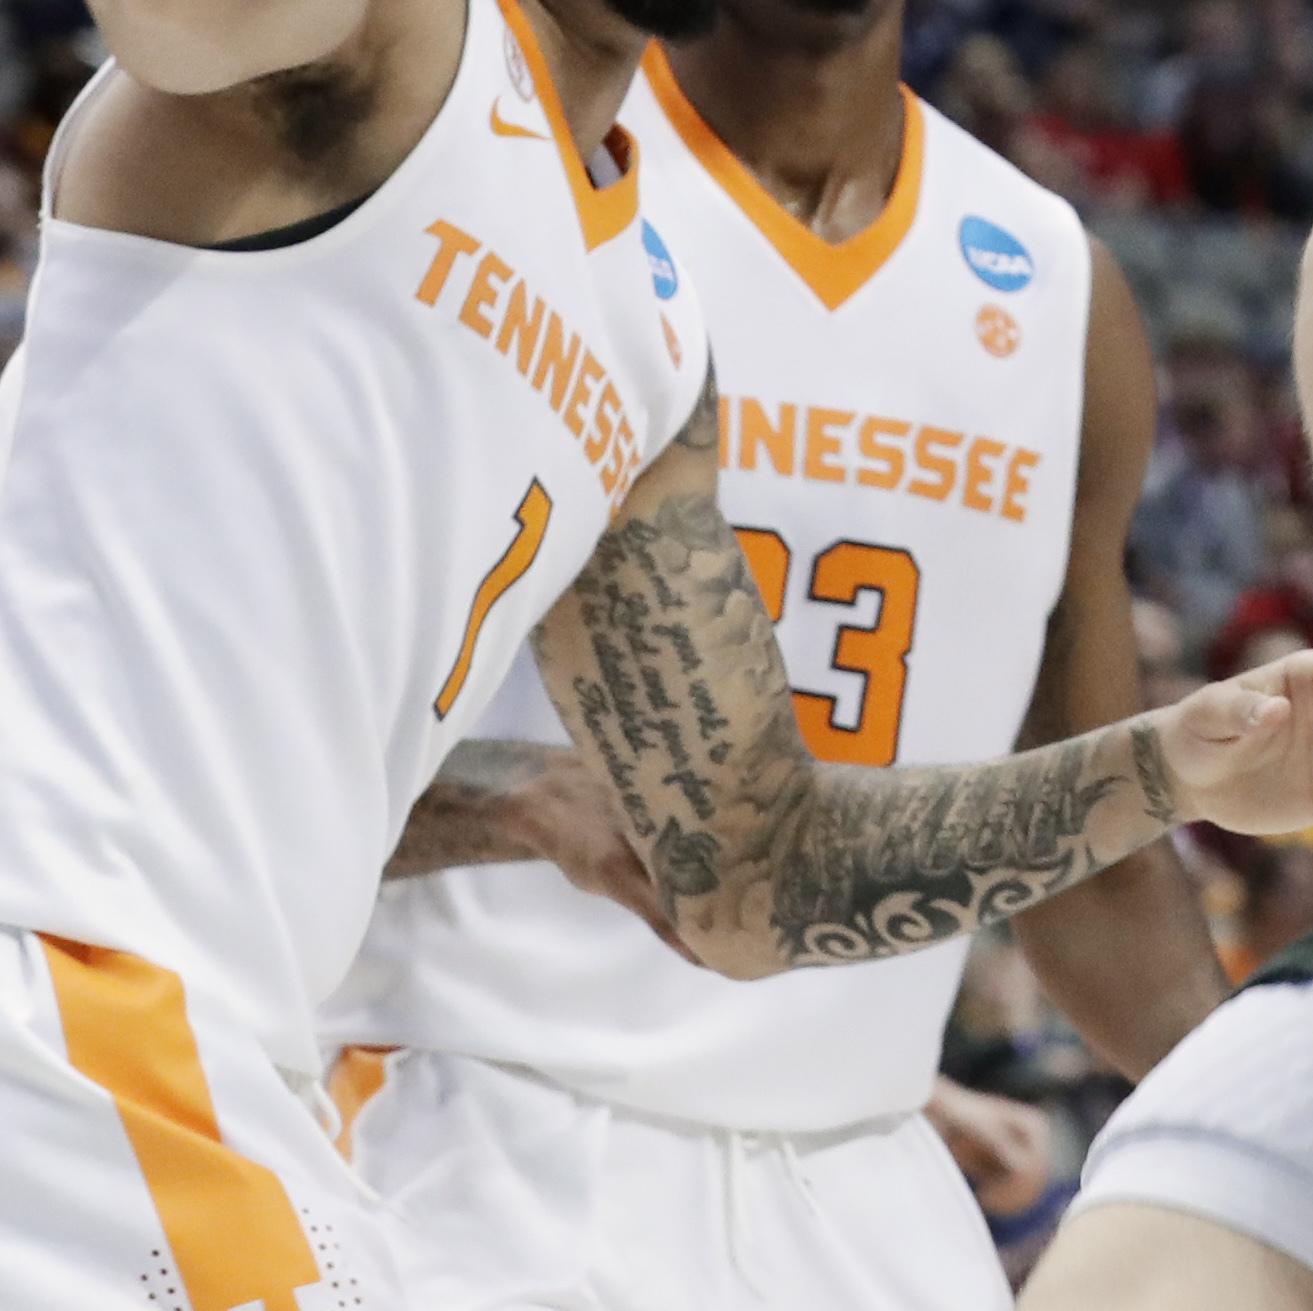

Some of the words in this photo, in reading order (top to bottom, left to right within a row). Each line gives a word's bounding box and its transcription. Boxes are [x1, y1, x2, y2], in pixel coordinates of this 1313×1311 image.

[414, 218, 641, 525] TENNESS
[718, 396, 1043, 523] NESSEE
[433, 474, 554, 722] 1
